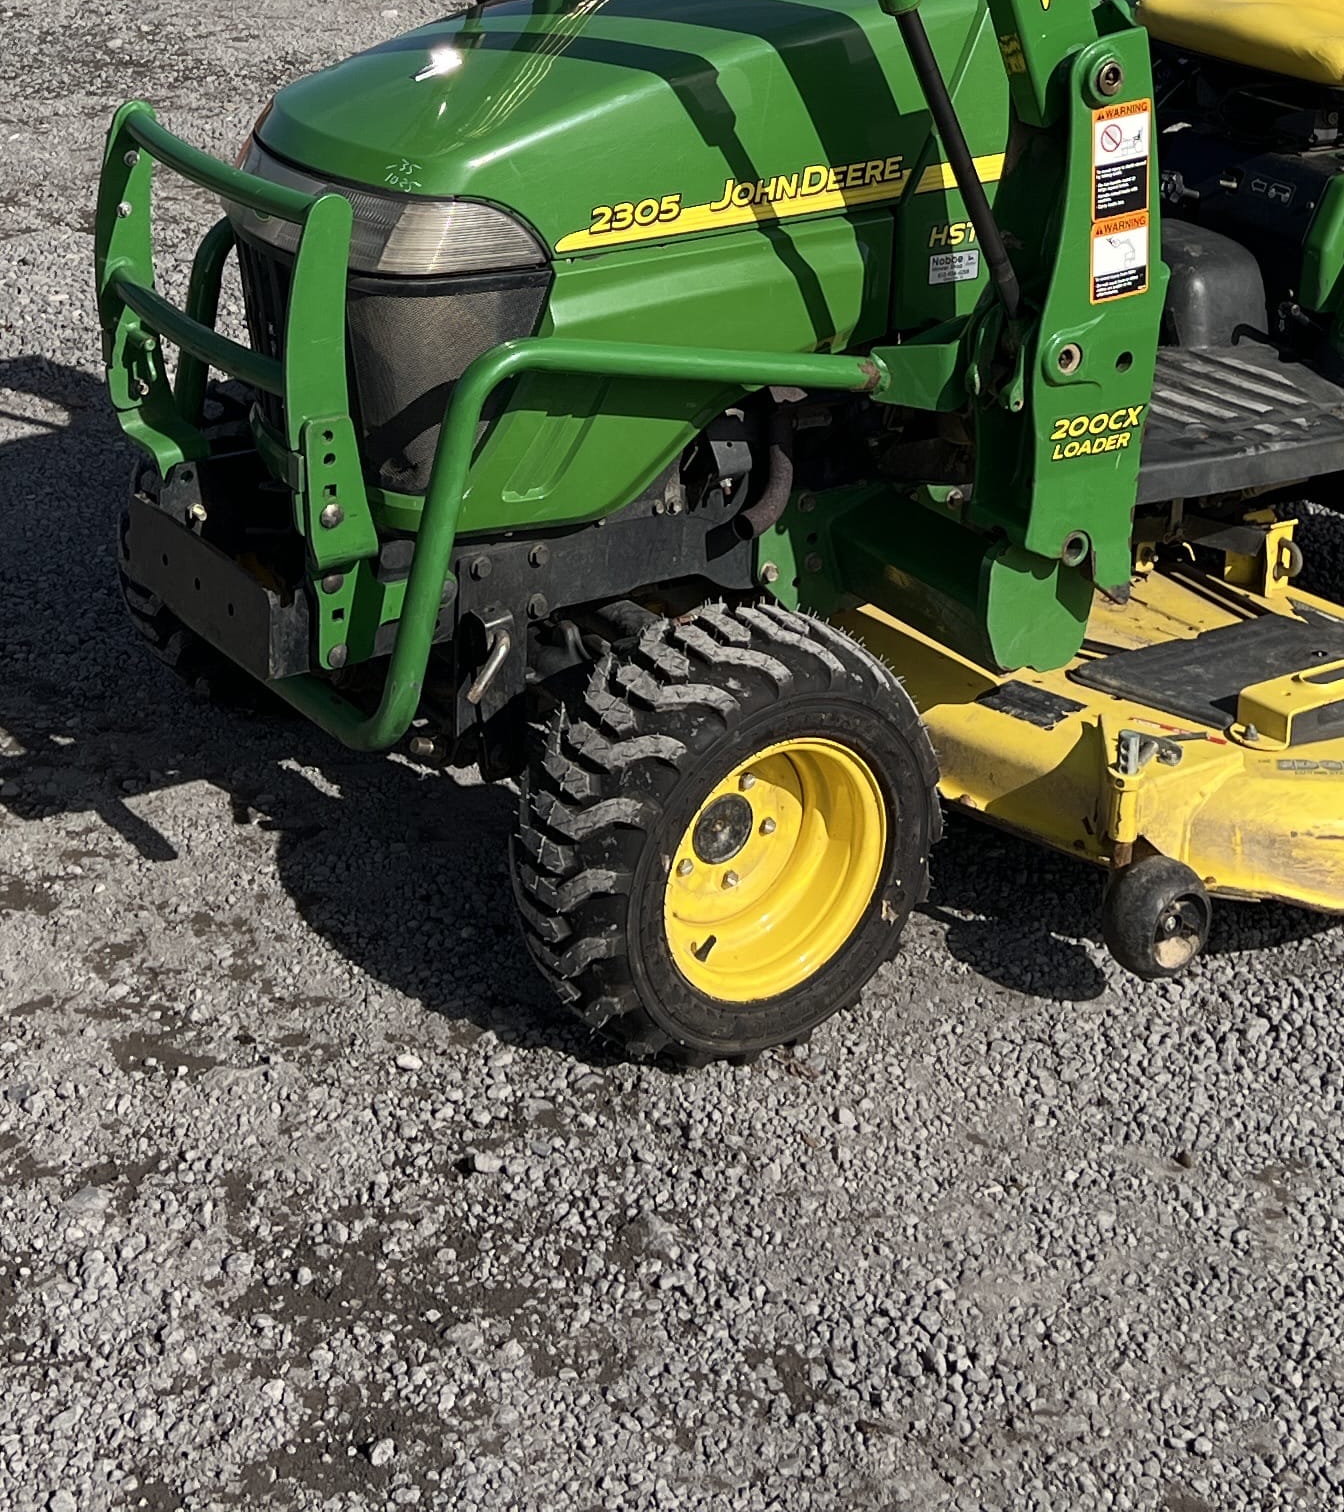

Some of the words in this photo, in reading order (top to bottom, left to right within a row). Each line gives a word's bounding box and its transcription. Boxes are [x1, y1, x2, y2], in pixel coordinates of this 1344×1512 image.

[1105, 101, 1148, 119] WARNING
[589, 193, 682, 235] 2305
[710, 172, 801, 212] JOHN
[799, 155, 904, 197] DEERE
[929, 221, 976, 247] HST
[1103, 215, 1146, 233] WARNING
[1050, 404, 1145, 440] 200CX
[1052, 432, 1132, 460] LOADER
